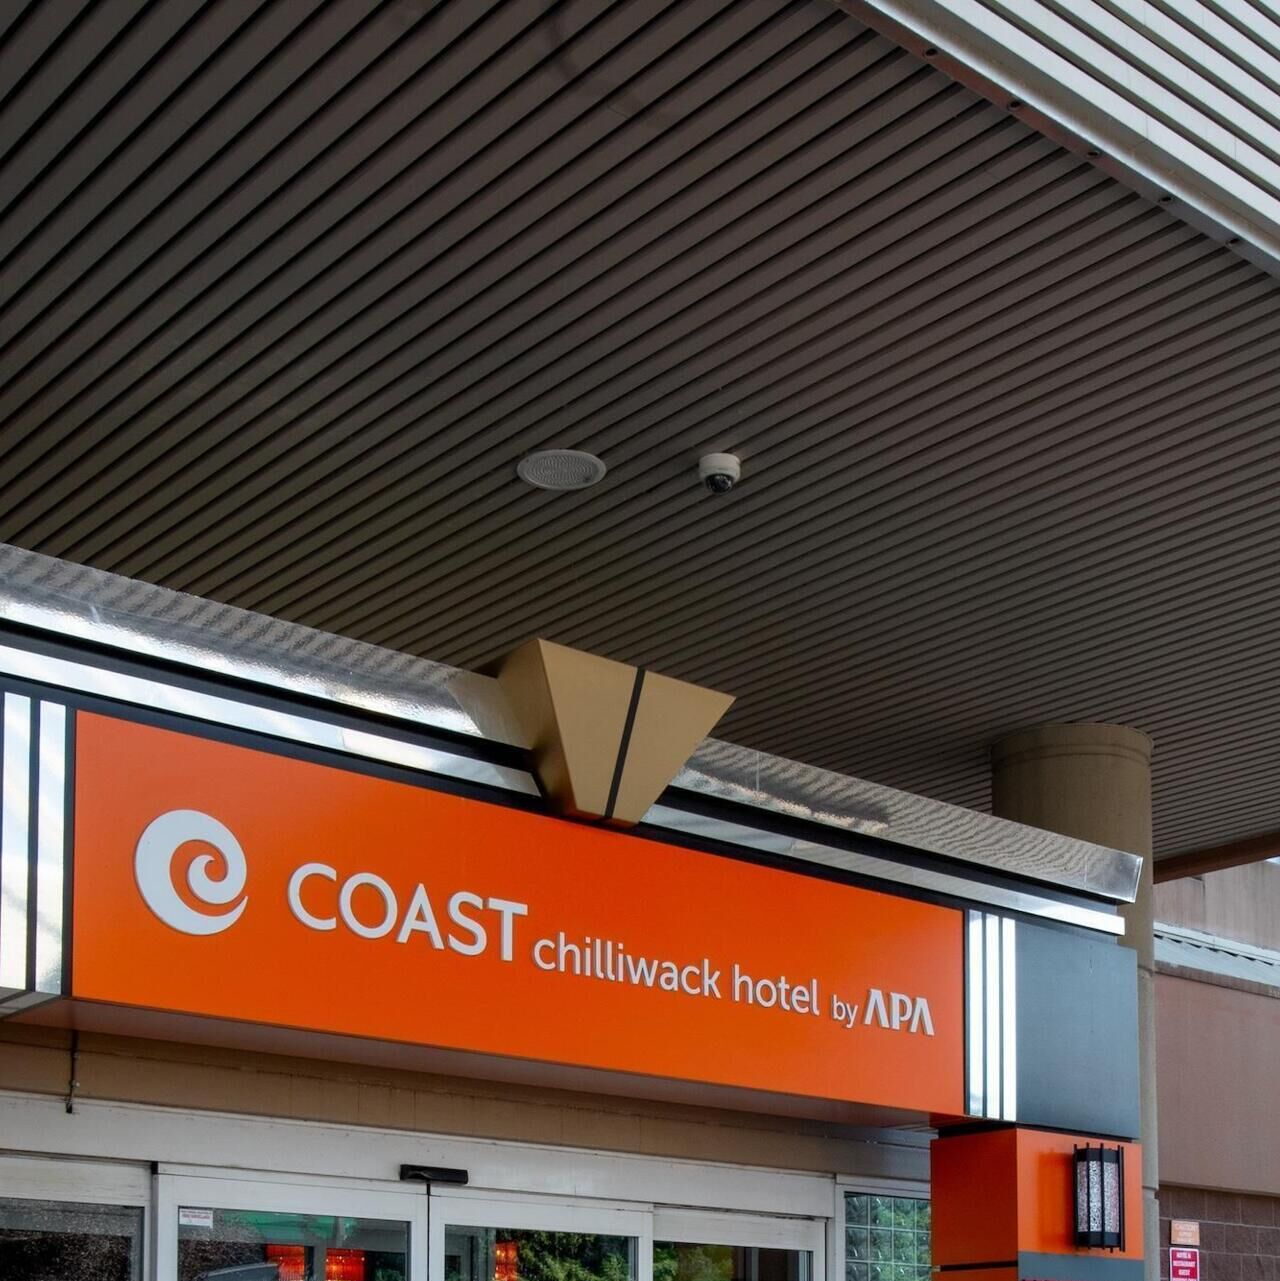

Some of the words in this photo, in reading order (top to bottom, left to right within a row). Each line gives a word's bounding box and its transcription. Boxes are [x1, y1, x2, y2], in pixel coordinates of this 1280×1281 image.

[288, 862, 529, 962] COAST
[533, 931, 721, 999] chilliwack
[732, 963, 820, 1016] hotel
[831, 993, 859, 1029] by
[864, 988, 935, 1036] APA
